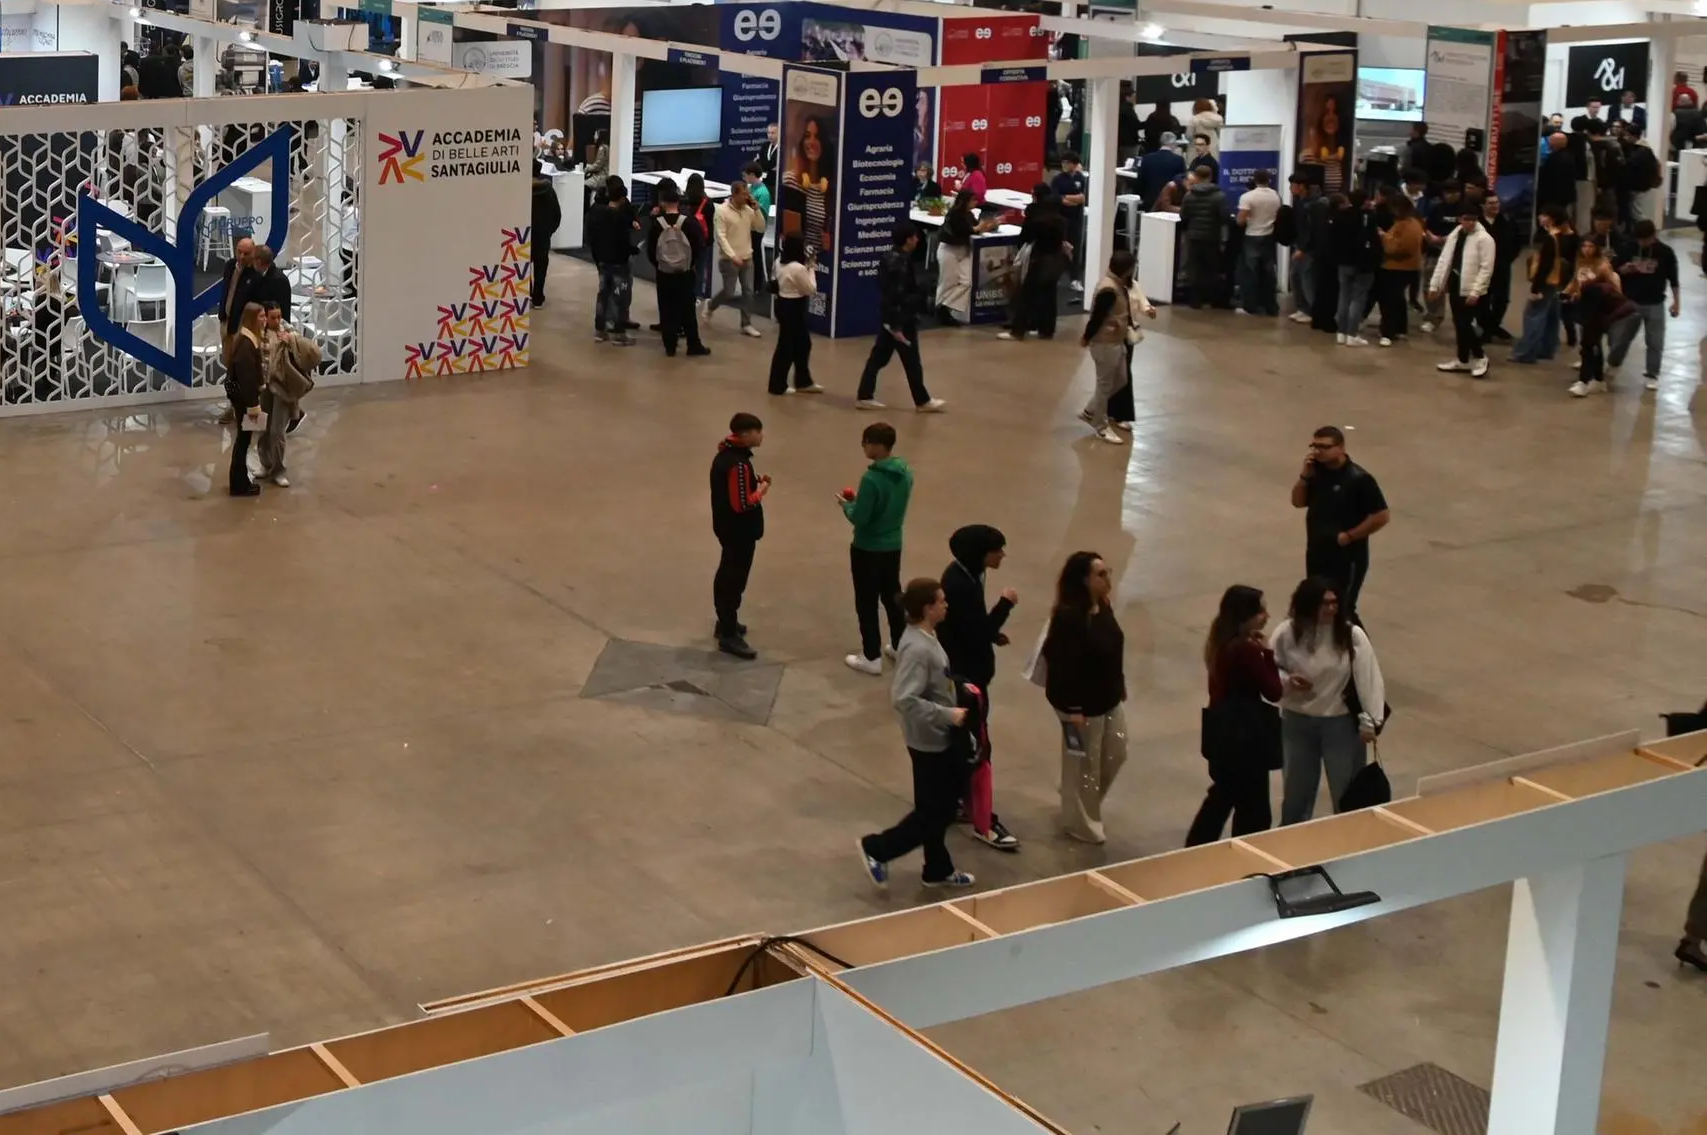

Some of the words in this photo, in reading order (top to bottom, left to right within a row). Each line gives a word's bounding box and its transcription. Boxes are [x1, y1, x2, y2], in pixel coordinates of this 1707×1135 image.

[19, 92, 87, 105] ACCADEMIA
[432, 128, 521, 145] ACCADEMIA
[432, 149, 444, 161] DI
[449, 147, 488, 159] BELLE
[492, 145, 519, 157] ARTI
[865, 144, 894, 154] Agraria
[431, 160, 521, 177] SANTAGIULIA
[859, 173, 896, 182] Economia
[859, 187, 894, 196] Farmacia
[847, 201, 904, 211] Giurisprudenza
[855, 215, 895, 226] Ingegneria
